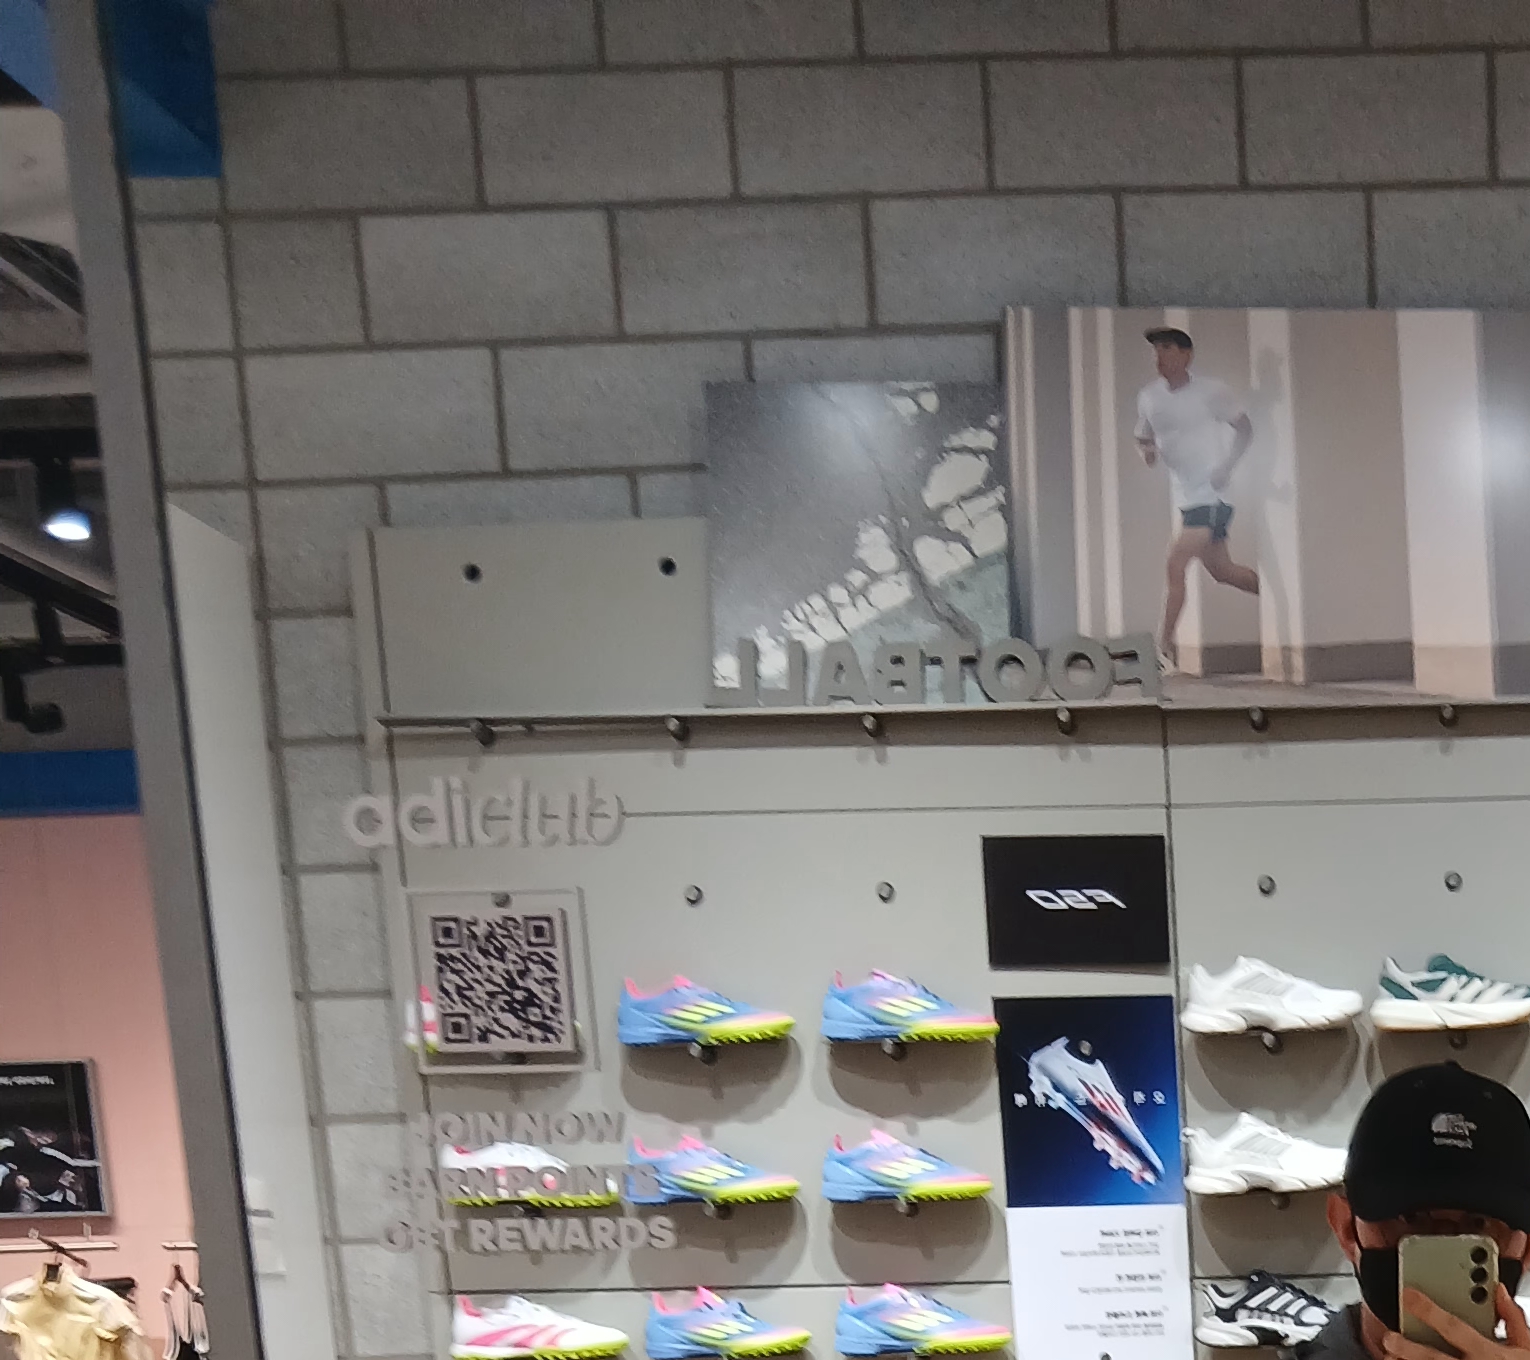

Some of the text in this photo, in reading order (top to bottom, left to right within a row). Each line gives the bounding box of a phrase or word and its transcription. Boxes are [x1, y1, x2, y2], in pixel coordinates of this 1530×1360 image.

[346, 775, 624, 848] adiclub
[512, 1111, 627, 1145] NOW
[504, 1163, 662, 1200] POINTS
[470, 1214, 678, 1252] REWARDS
